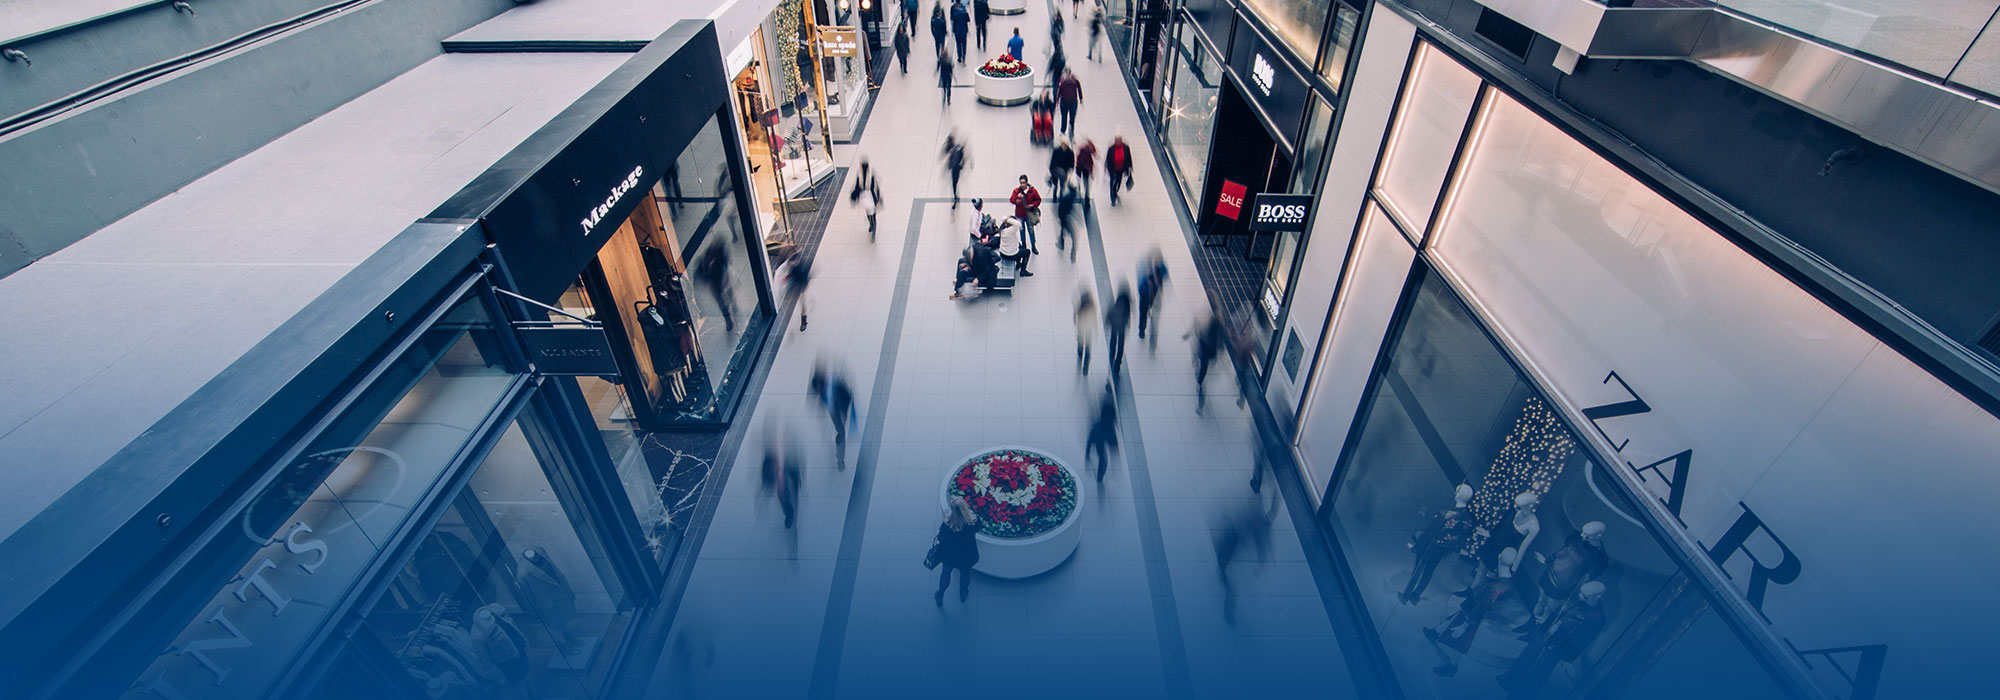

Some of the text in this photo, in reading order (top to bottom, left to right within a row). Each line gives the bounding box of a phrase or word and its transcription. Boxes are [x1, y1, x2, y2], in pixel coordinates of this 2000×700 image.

[581, 165, 643, 236] Mackage
[1220, 193, 1242, 208] SALE
[1258, 204, 1305, 218] BOSS
[1581, 370, 1888, 700] ZARA
